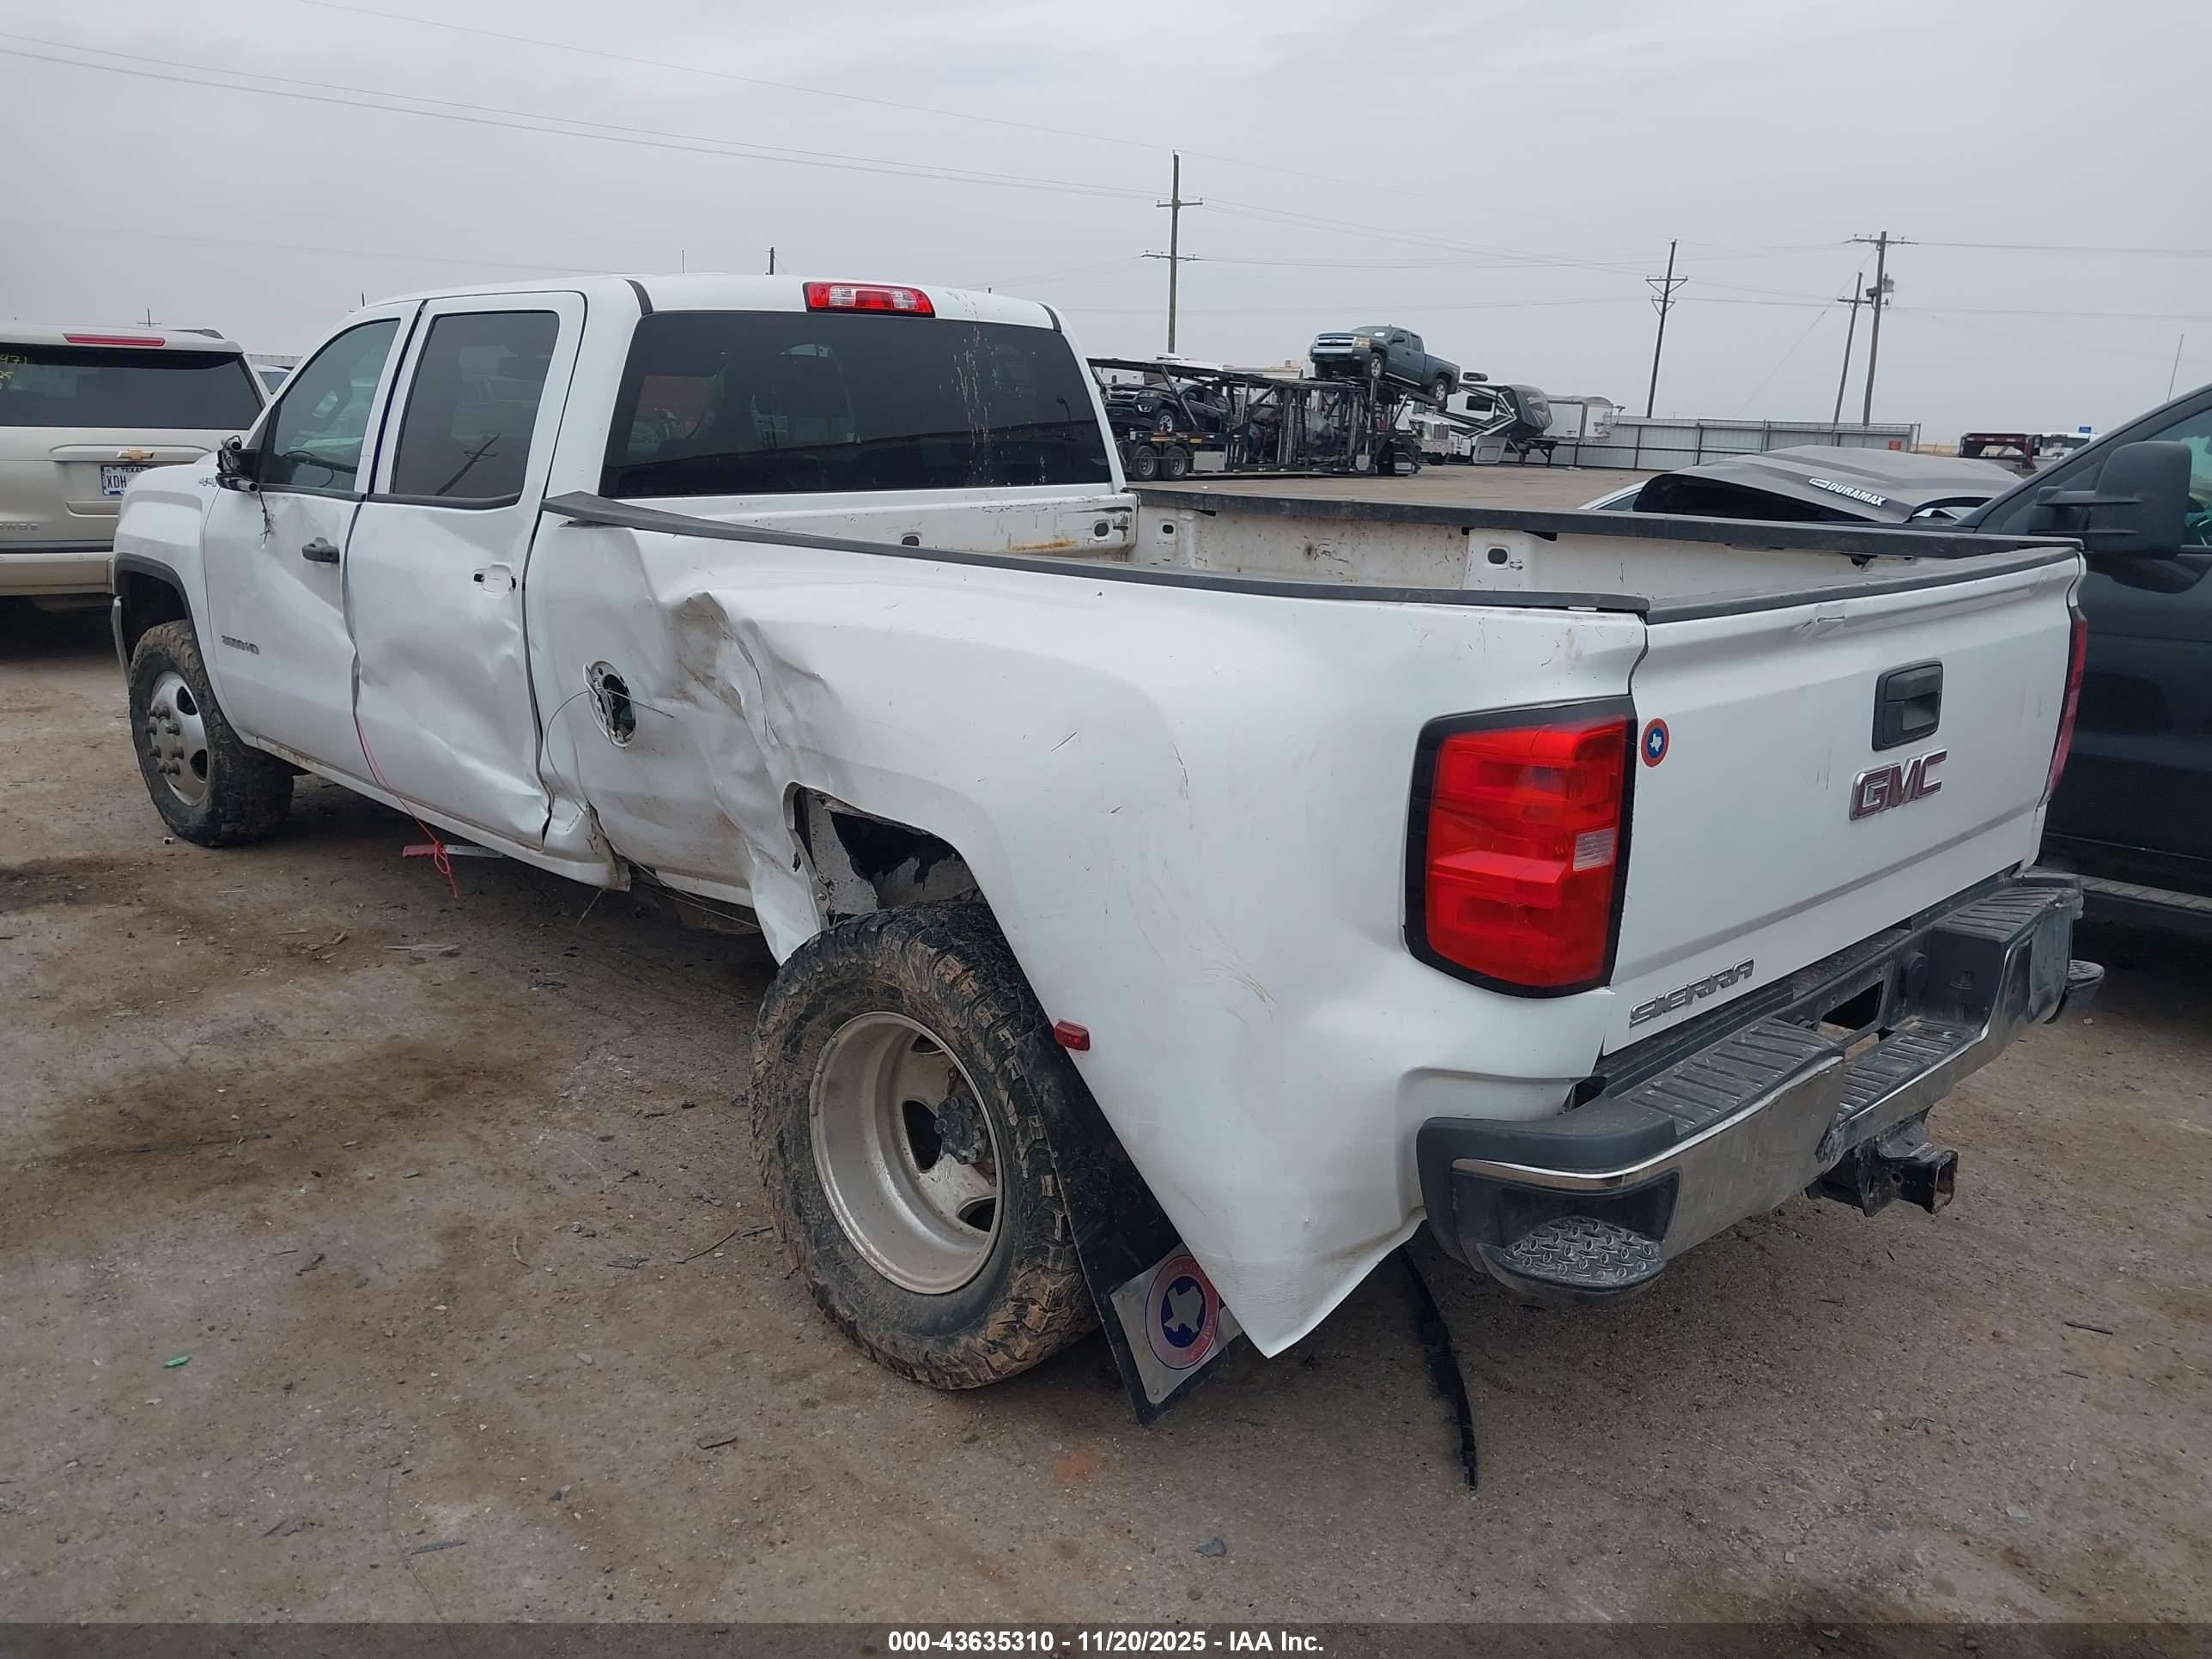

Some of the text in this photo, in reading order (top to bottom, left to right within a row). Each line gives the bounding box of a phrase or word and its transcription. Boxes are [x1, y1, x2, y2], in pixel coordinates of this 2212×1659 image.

[1826, 482, 1887, 507] DURAMAX
[1849, 748, 1948, 821] GMC
[1629, 957, 1755, 1029] SIERRA
